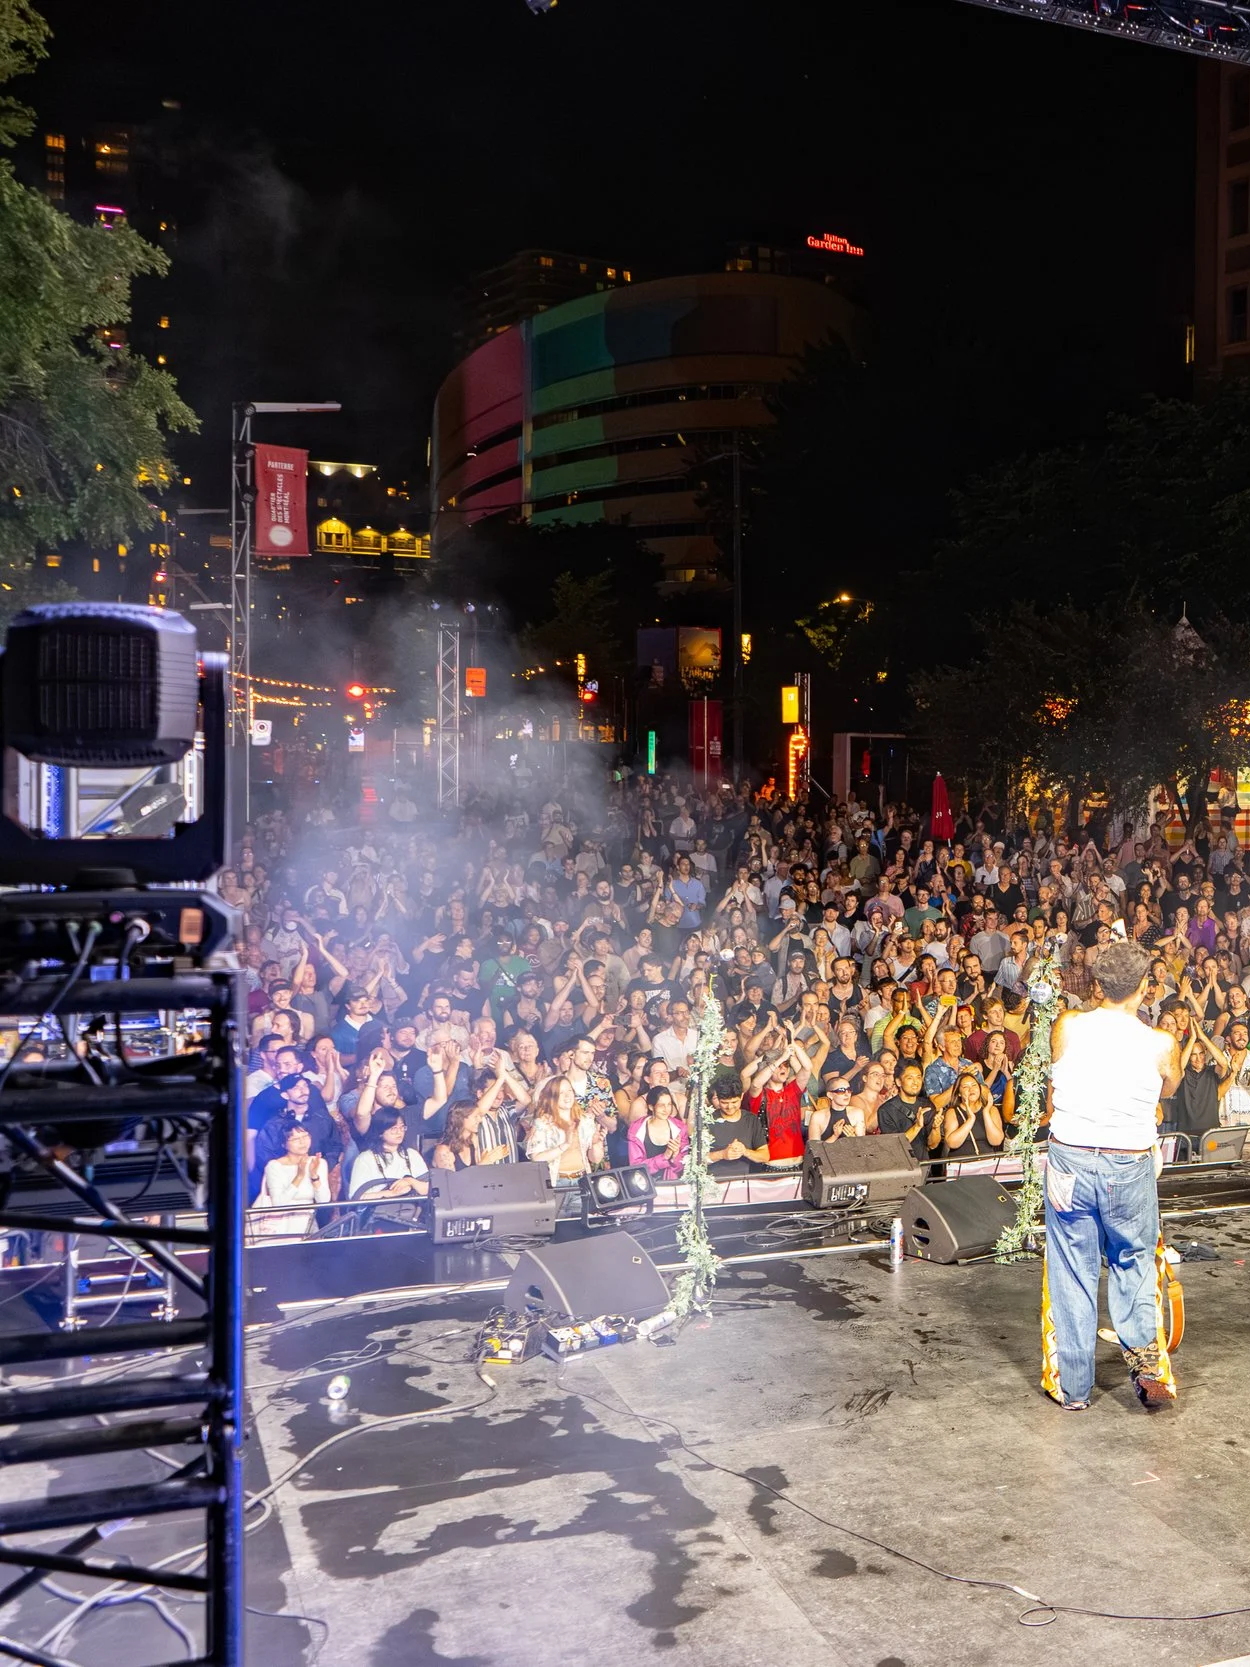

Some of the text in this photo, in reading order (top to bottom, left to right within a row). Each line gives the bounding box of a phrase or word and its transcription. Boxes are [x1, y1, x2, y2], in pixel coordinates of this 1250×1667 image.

[807, 236, 864, 256] Garden Inn
[823, 233, 848, 244] Hilton
[267, 461, 294, 471] PARTERRE
[276, 474, 284, 510] SPECTACLES
